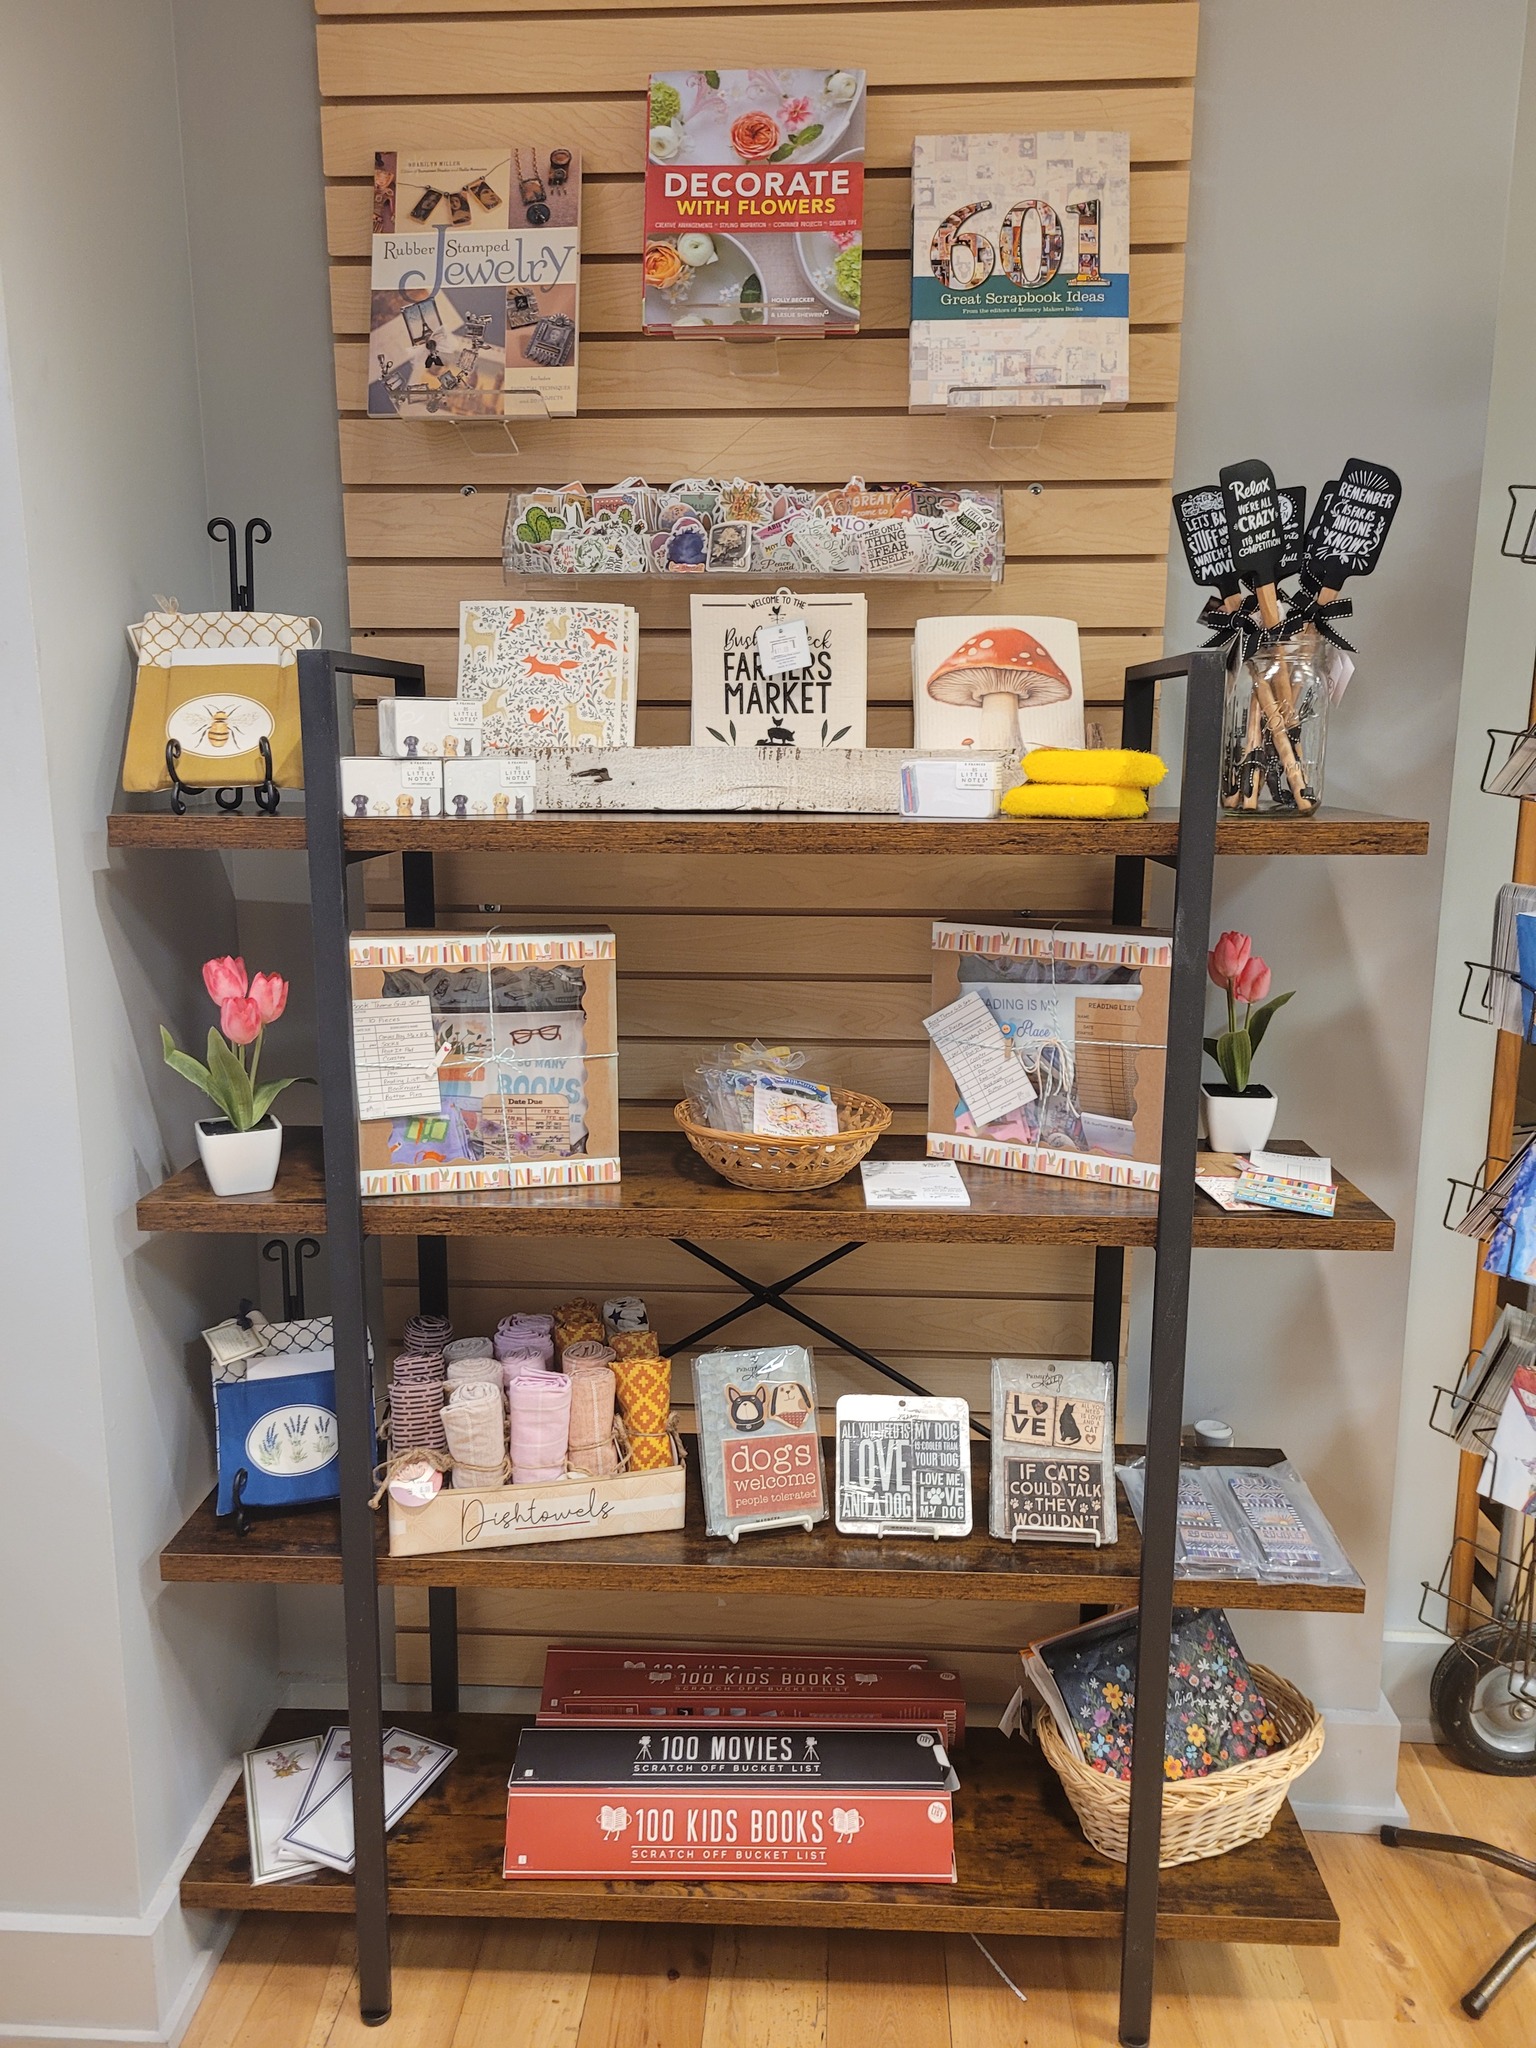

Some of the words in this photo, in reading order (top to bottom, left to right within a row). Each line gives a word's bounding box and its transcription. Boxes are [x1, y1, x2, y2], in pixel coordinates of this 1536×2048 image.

[665, 170, 850, 197] DECORATE
[676, 200, 730, 216] WITH
[738, 198, 836, 214] FLOWERS
[384, 240, 435, 260] Rubber
[445, 240, 510, 258] Stamped
[930, 198, 1112, 290] 601
[398, 224, 576, 302] Jewelry
[940, 294, 982, 305] Great
[985, 292, 1062, 306] Scrapbook
[1066, 291, 1105, 302] Ideas
[1228, 477, 1270, 501] Relax
[1338, 482, 1394, 509] REMEMBER
[852, 494, 894, 507] GREAT
[1237, 500, 1260, 516] WE'RE
[1260, 496, 1272, 509] ALL
[1237, 507, 1275, 533] CRAZY
[1341, 504, 1352, 515] AS
[1350, 506, 1366, 519] FAR
[1364, 510, 1376, 521] AS
[881, 522, 903, 534] ONLY
[1186, 514, 1210, 532] LET'S
[1332, 515, 1375, 537] ANYONE
[865, 530, 906, 549] THING
[1188, 529, 1218, 555] STUFF
[1255, 530, 1270, 543] NOT
[1271, 528, 1276, 538] A
[1323, 530, 1373, 555] KNOWS
[875, 540, 908, 557] FEAR
[1239, 537, 1281, 558] COMPETITION
[761, 559, 791, 570] Peace
[1194, 548, 1225, 567] WATCH
[748, 596, 780, 610] WELCOME
[782, 596, 791, 605] TO
[794, 598, 806, 610] THE
[724, 652, 832, 681] FARRS
[724, 682, 832, 715] MARKET
[1028, 1000, 1037, 1010] IS
[1016, 1019, 1050, 1038] Place
[534, 1059, 566, 1069] MANY
[498, 1074, 581, 1104] BOOKS
[842, 1422, 859, 1438] ALL
[859, 1422, 879, 1438] YOU
[900, 1422, 910, 1438] IS
[915, 1422, 934, 1440] MY
[935, 1422, 958, 1440] DOG
[915, 1441, 921, 1450] IS
[921, 1441, 942, 1451] COOLER
[943, 1442, 958, 1451] THAN
[731, 1444, 812, 1474] dogs
[843, 1439, 911, 1492] LOVE
[915, 1452, 939, 1466] YOUR
[940, 1452, 958, 1467] DOG
[734, 1472, 816, 1492] welcome
[920, 1473, 944, 1485] LOVE
[946, 1473, 963, 1486] ME,
[1020, 1464, 1036, 1480] IF
[1045, 1465, 1090, 1482] CATS
[735, 1495, 769, 1508] people
[771, 1489, 817, 1503] tolerated
[1010, 1481, 1062, 1496] COULD
[1068, 1483, 1101, 1498] TALK
[842, 1492, 872, 1518] AND
[873, 1492, 880, 1517] A
[885, 1492, 912, 1518] DOG
[920, 1506, 936, 1518] MY
[942, 1507, 964, 1519] DOG
[1035, 1498, 1077, 1512] THEY
[461, 1488, 614, 1545] Dishtowels
[1014, 1513, 1099, 1529] WOULDN'T
[680, 1672, 714, 1685] 100
[725, 1672, 770, 1685] KIDS
[782, 1673, 846, 1685] BOOKS
[661, 1736, 699, 1761] 100
[711, 1736, 793, 1761] MOVIES
[636, 1809, 674, 1842] 100
[687, 1809, 738, 1843] KIDS
[751, 1809, 824, 1843] BOOKS
[632, 1850, 694, 1858] SCRATCH
[703, 1851, 728, 1859] OFF
[736, 1851, 788, 1860] BUCKET
